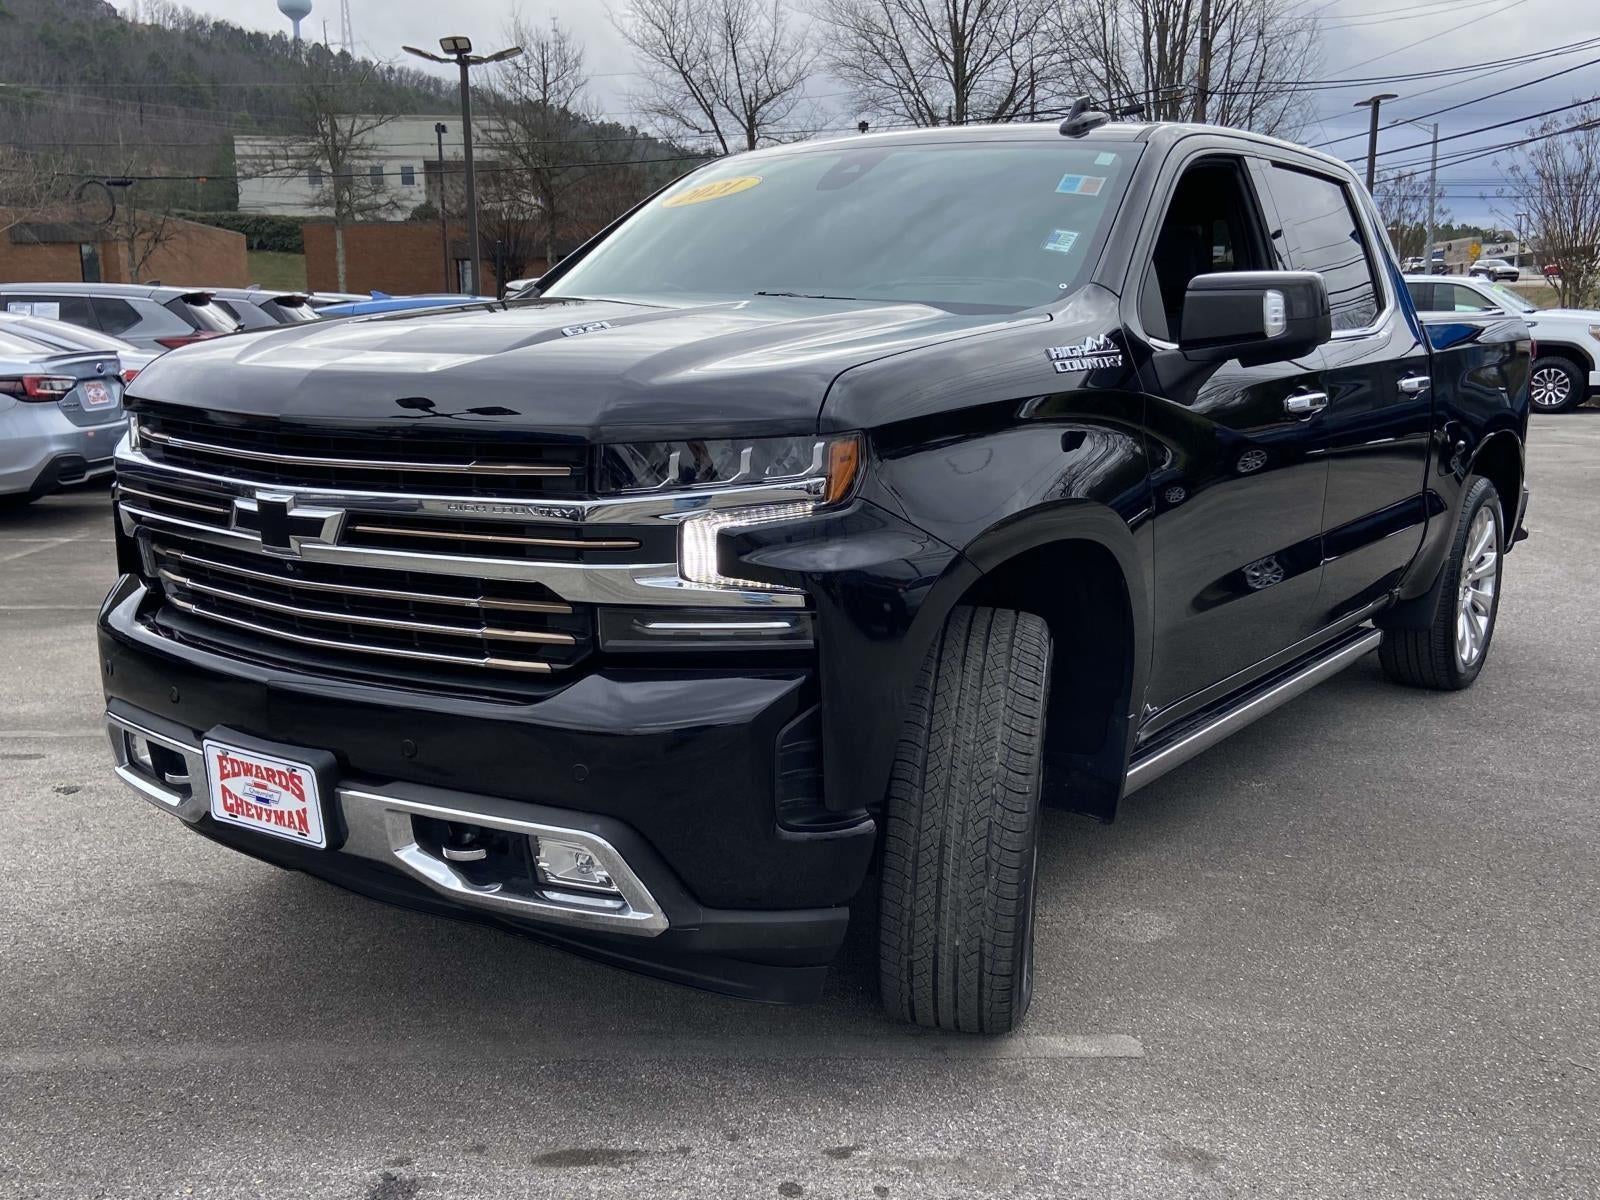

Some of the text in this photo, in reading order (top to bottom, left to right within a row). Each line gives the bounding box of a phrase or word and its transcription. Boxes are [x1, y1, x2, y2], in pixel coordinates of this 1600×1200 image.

[1045, 345, 1088, 360] HIGH
[1053, 354, 1122, 374] COUNTRY
[447, 503, 487, 513] HIGH
[216, 754, 306, 803] EDWARDS
[220, 783, 311, 834] CHEVYMAN
